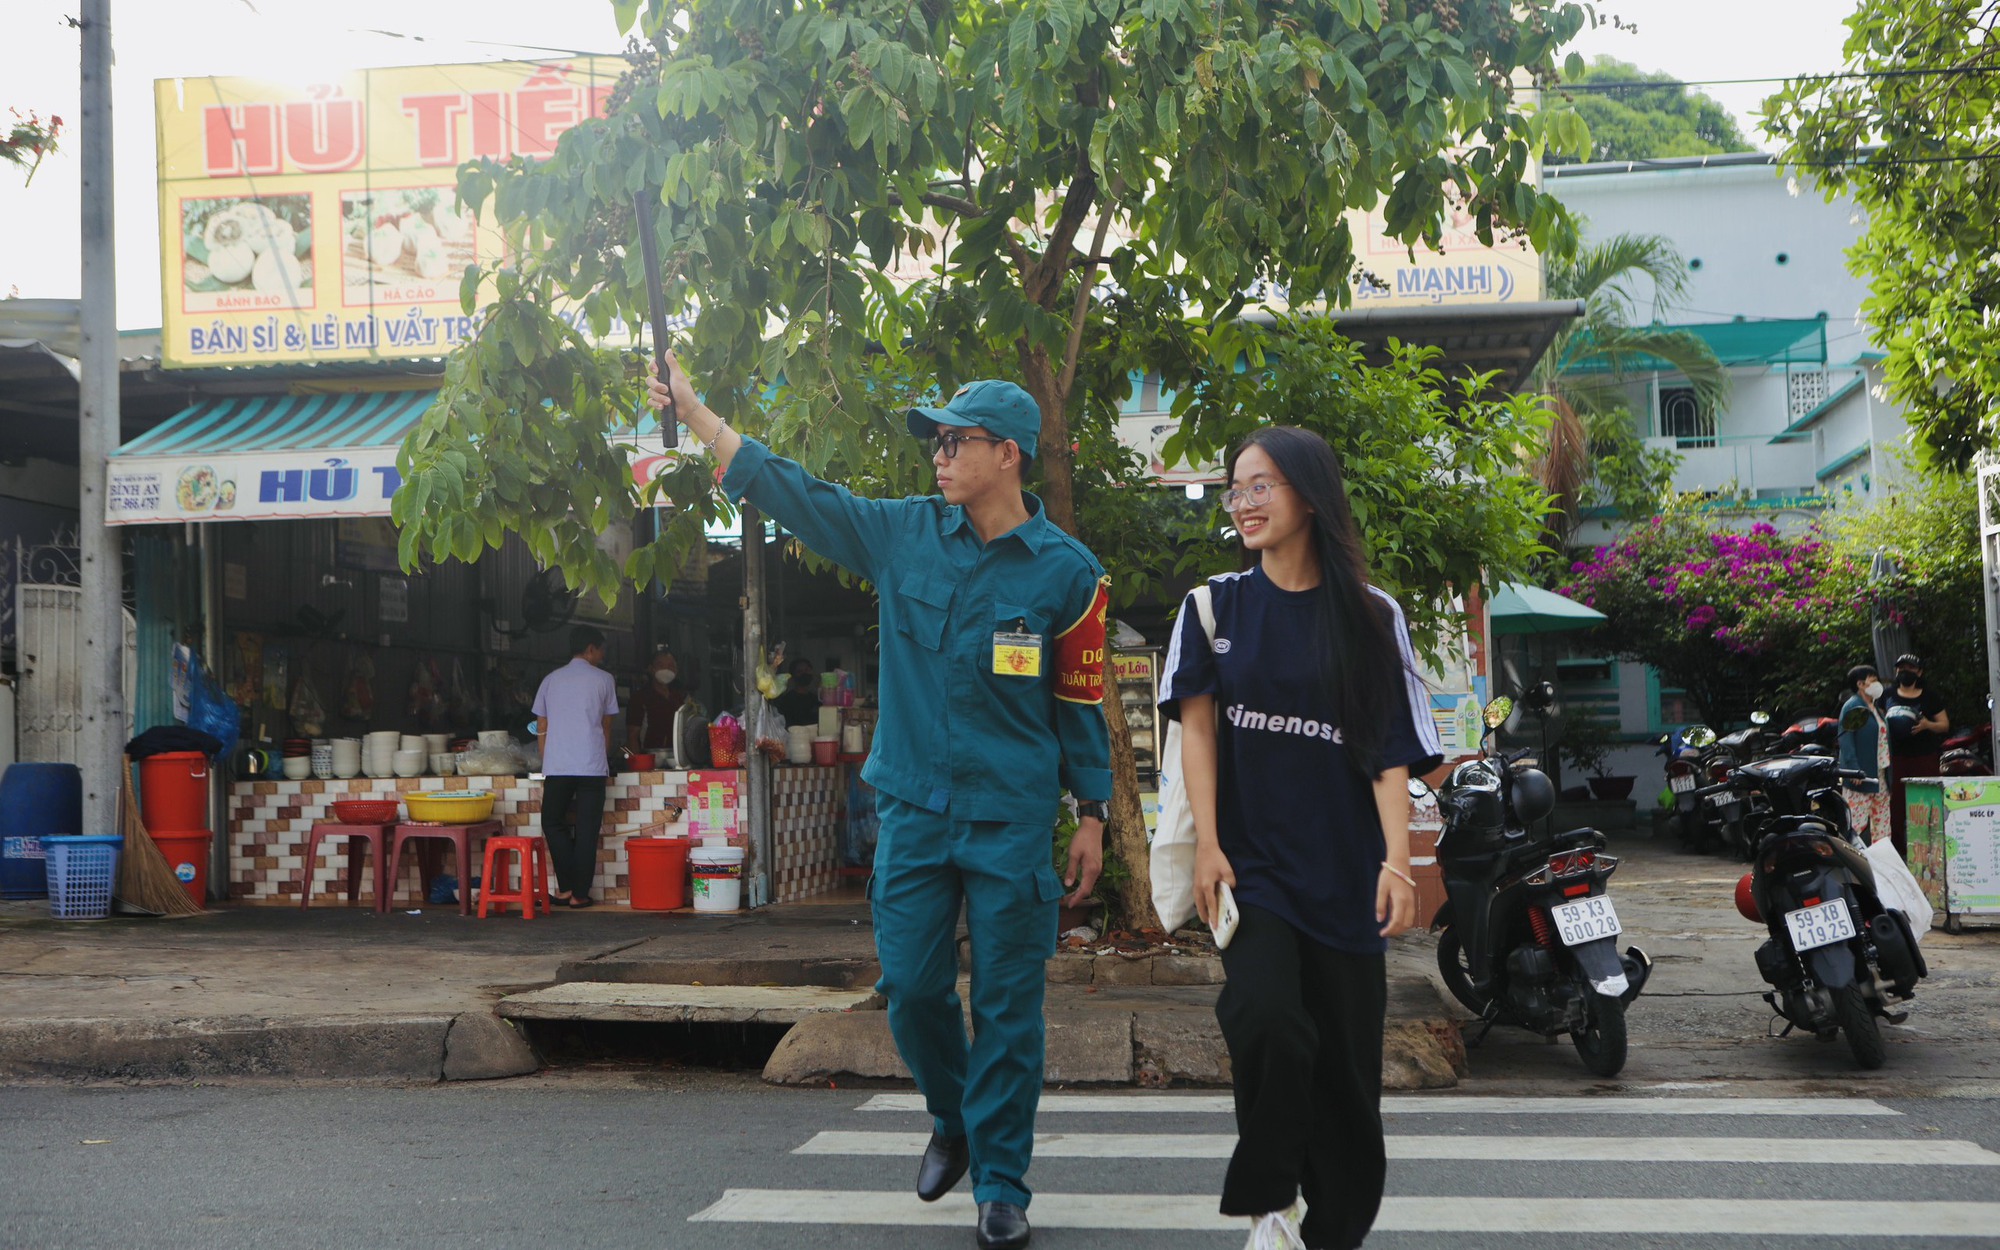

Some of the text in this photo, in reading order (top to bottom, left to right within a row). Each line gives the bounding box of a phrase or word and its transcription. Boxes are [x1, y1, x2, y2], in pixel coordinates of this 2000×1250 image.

[402, 63, 612, 166] TIẾ
[284, 323, 306, 350] &
[312, 314, 339, 351] LẺ
[345, 313, 379, 349] MÌ
[259, 458, 359, 503] HỦ
[1561, 899, 1605, 923] 59-X3
[1563, 916, 1617, 942] 600.28
[1798, 920, 1849, 947] 419.25
